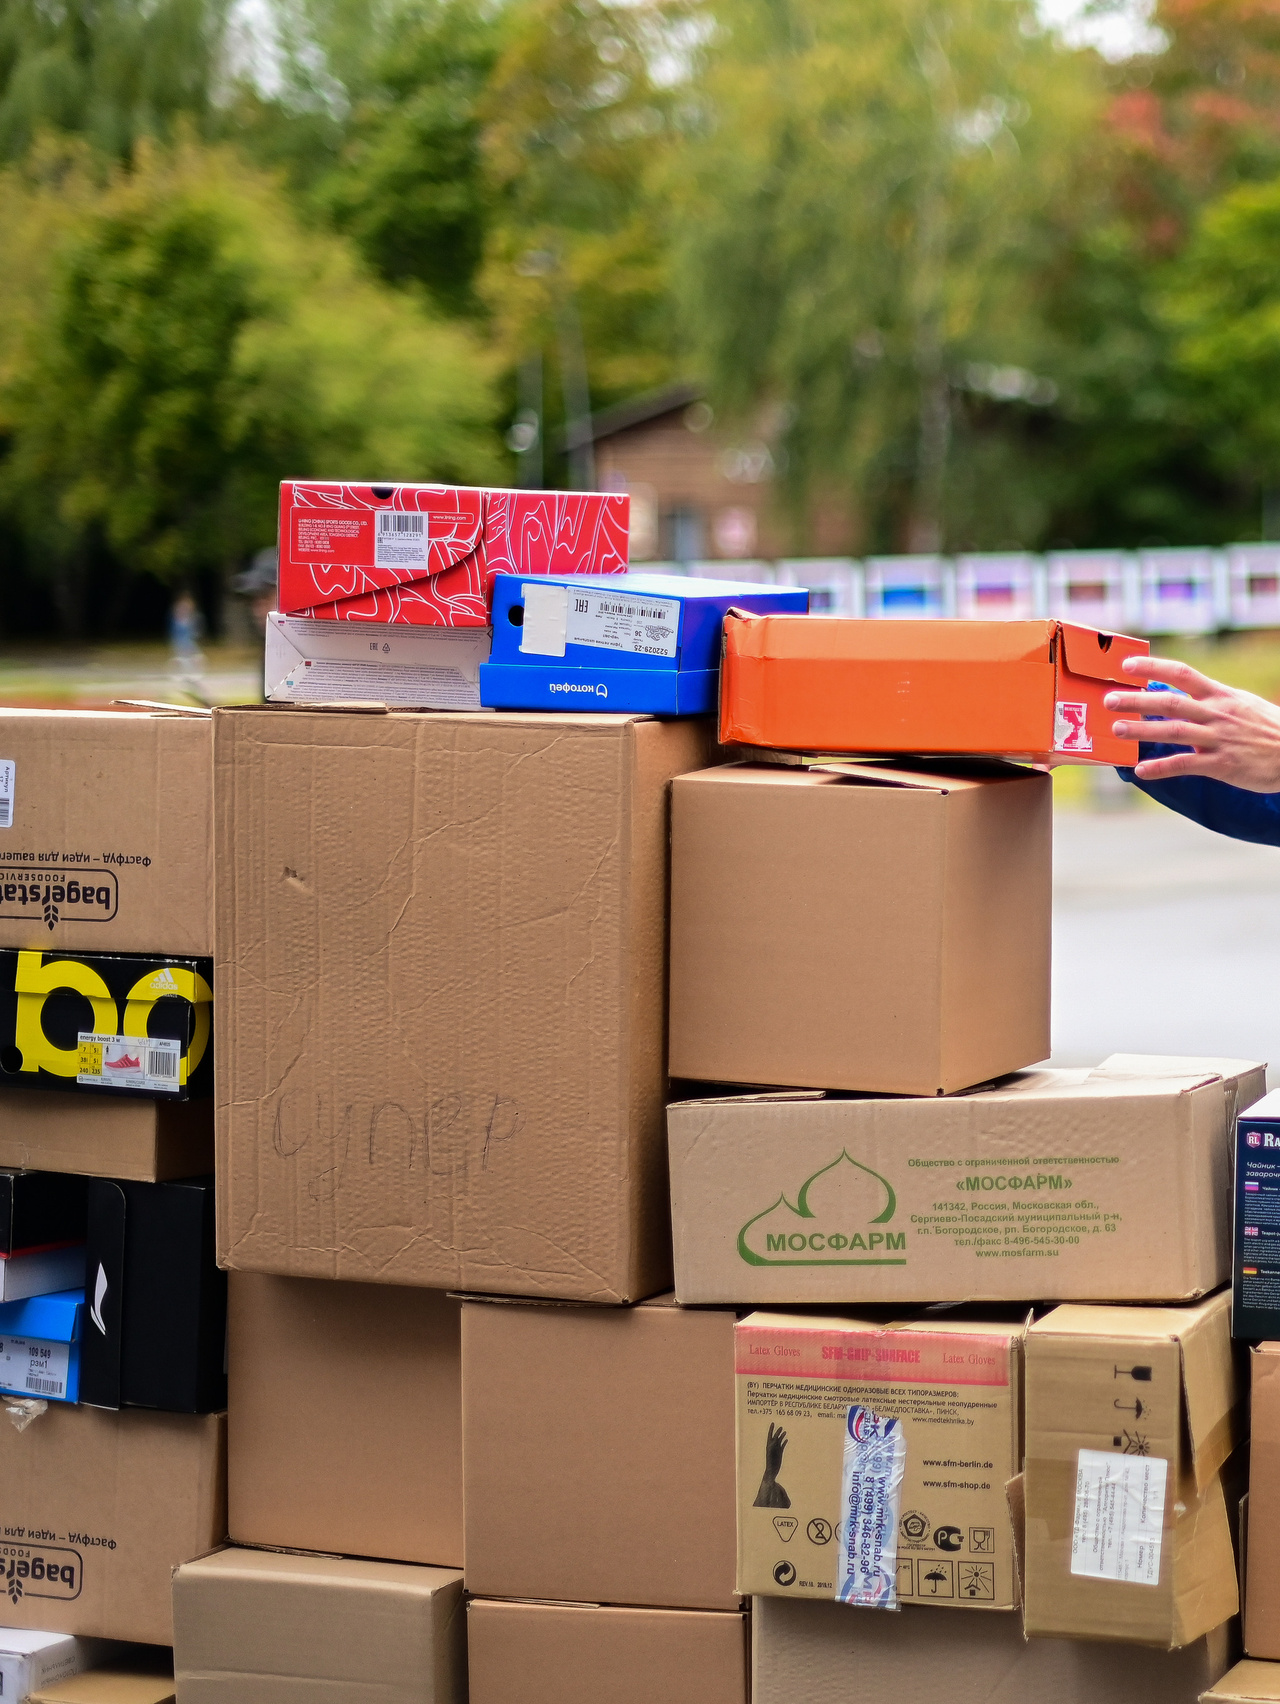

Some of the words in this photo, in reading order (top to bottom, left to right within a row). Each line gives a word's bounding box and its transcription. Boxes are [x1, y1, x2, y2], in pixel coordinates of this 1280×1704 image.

[634, 644, 668, 656] 522029-25
[38, 852, 59, 862] для
[62, 854, 90, 863] идеи
[103, 852, 151, 867] Фастфуд
[150, 982, 178, 990] adidas
[80, 1034, 96, 1043] energy
[1249, 1136, 1260, 1144] RL
[908, 1159, 955, 1168] Общество
[965, 1157, 1030, 1167] ограниченной
[1032, 1156, 1120, 1165] ответственностью
[956, 1174, 1073, 1191] «МОСФАРМ»
[932, 1203, 969, 1212] 141342,
[971, 1202, 1010, 1212] Россия,
[1012, 1201, 1072, 1210] Московская
[1074, 1201, 1099, 1210] обл.,
[910, 1214, 1015, 1224] Сергиево-Посадский
[1017, 1212, 1101, 1222] муниципальный
[1104, 1214, 1122, 1222] р-н,
[917, 1227, 932, 1236] г.п.
[935, 1226, 1002, 1235] Богородское,
[1022, 1224, 1090, 1234] Богородское,
[1093, 1225, 1102, 1233] д.
[1105, 1224, 1116, 1232] 63
[766, 1232, 906, 1251] МОСФАРМ
[954, 1238, 1001, 1247] тел./факс
[1004, 1236, 1080, 1245] 8-496-545-30-00
[975, 1249, 1059, 1258] www.mosfarm.su
[750, 1344, 770, 1355] Latex
[774, 1345, 800, 1357] Gloves
[822, 1346, 920, 1363] SFM-GRIP-SURFACE
[943, 1353, 964, 1363] Latex
[968, 1354, 995, 1365] Gloves
[795, 1384, 841, 1393] МЕДИЦИНСКИЕ
[843, 1387, 889, 1395] ОДНОРАЗОВЫЕ
[908, 1390, 959, 1398] ТИПОРАЗМЕРОВ:
[948, 1401, 997, 1409] неопудренные
[912, 1417, 974, 1425] www.medtekhnika.by
[923, 1459, 993, 1469] www.sfm-berlin.de
[923, 1480, 991, 1490] www.sfm-shop.de
[861, 1487, 874, 1515] (499)
[1140, 1483, 1149, 1523] Количество
[847, 1471, 862, 1574] info@mrk-snab.ru
[873, 1477, 886, 1577] www.mrk-snab.ru
[5, 1527, 25, 1537] для
[28, 1529, 56, 1540] идеи
[69, 1532, 117, 1550] Фастфуд
[1092, 1524, 1100, 1553] Общество
[860, 1518, 872, 1574] 346-82-96
[0, 1548, 30, 1558] FOOD
